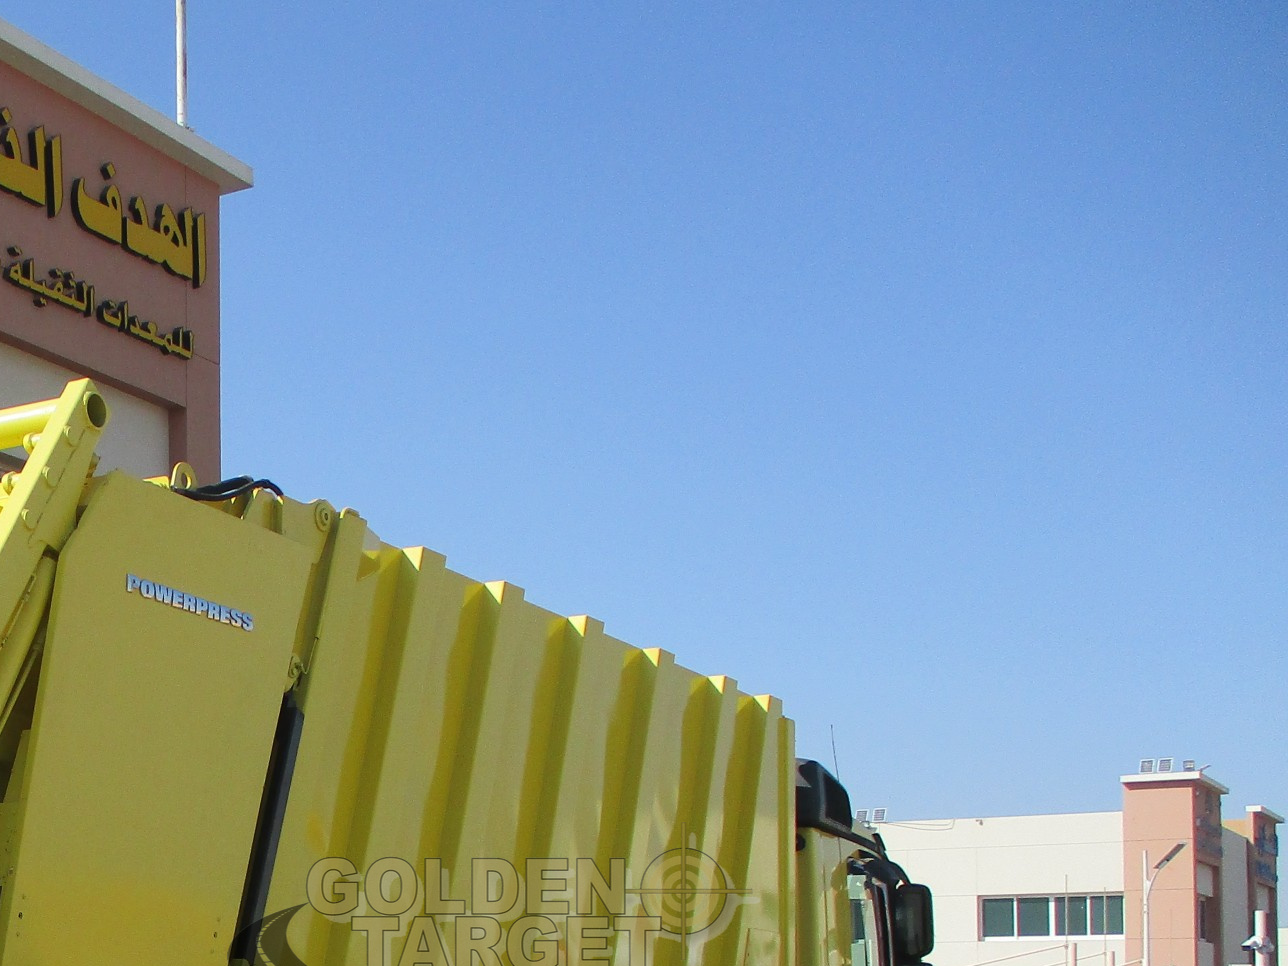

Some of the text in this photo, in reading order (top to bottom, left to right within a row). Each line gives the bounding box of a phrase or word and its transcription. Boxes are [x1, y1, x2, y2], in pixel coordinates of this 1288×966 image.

[72, 161, 207, 289] الهدف
[3, 245, 95, 317] الثقيلة
[97, 300, 194, 359] للمعدات
[126, 572, 254, 632] POWERPRESS
